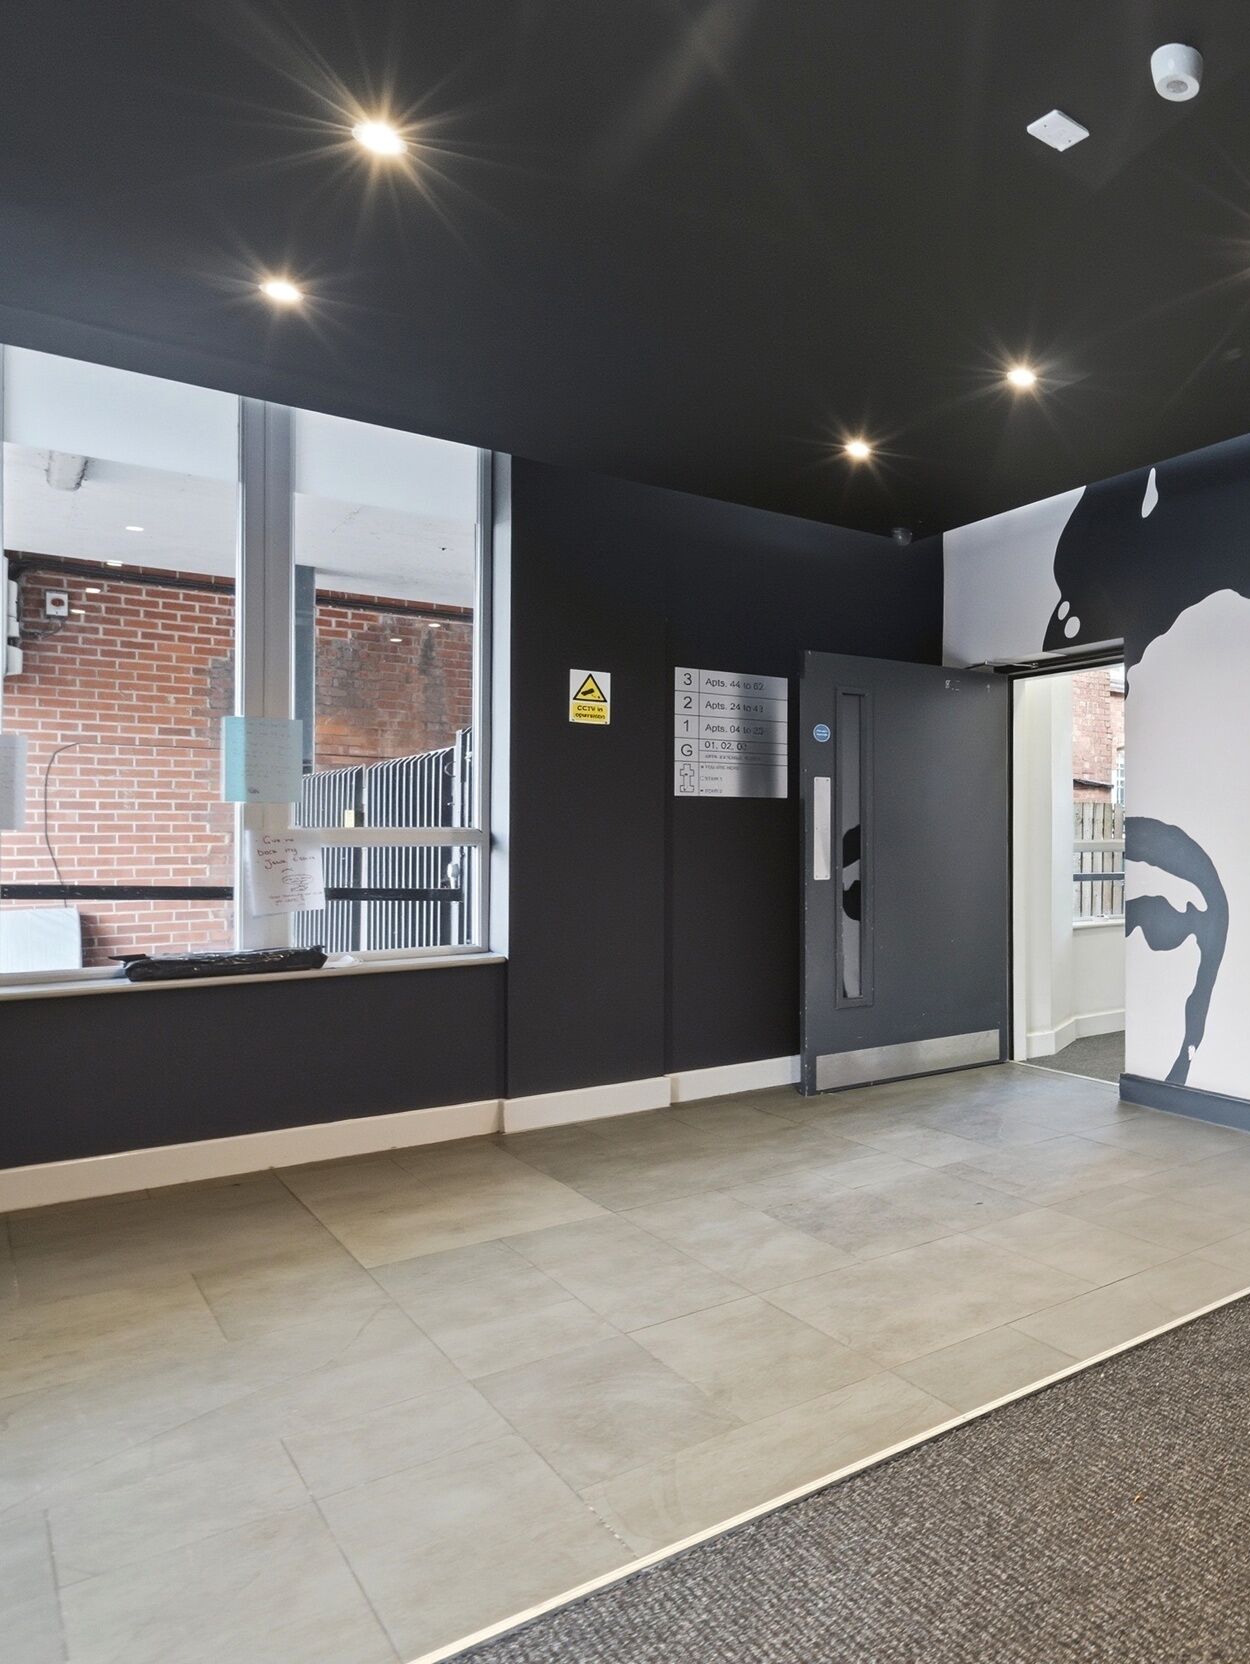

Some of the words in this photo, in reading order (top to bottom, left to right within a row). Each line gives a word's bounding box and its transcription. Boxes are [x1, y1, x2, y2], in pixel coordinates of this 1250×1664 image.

[683, 672, 692, 686] 3
[705, 678, 728, 688] Apts.
[729, 680, 741, 689] 44
[683, 696, 692, 709] 2
[705, 701, 728, 711] Apts.
[730, 703, 741, 711] 24
[743, 704, 752, 712] to
[683, 720, 689, 732] 1
[705, 724, 728, 733] Apts.
[730, 725, 741, 734] 04
[743, 726, 752, 735] to
[681, 744, 693, 757] G
